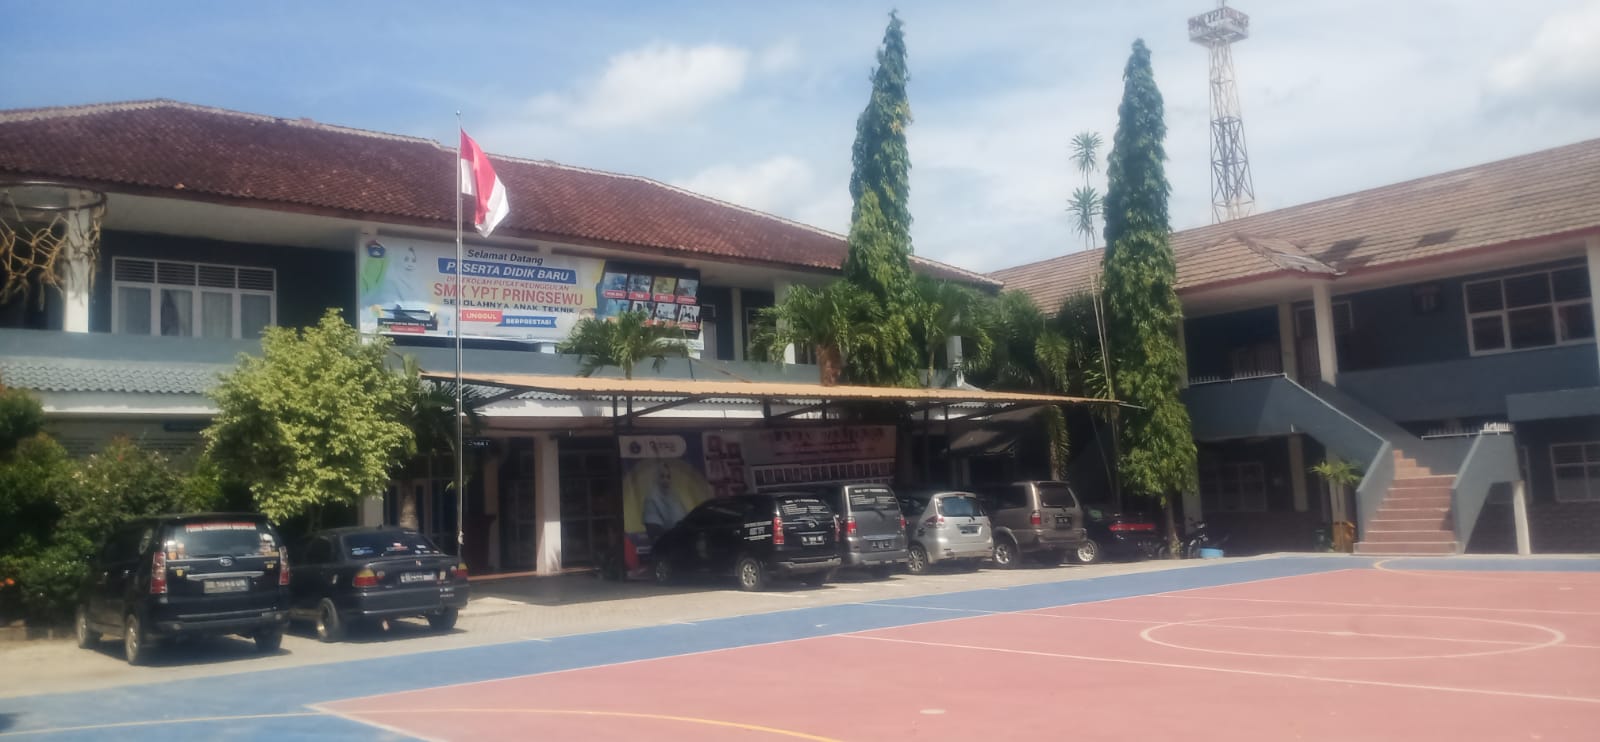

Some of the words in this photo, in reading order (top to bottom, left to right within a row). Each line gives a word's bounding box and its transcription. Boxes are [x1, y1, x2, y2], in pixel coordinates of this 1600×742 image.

[467, 249, 507, 261] Selamat
[510, 253, 544, 266] Datang
[446, 261, 500, 275] PSERTA
[503, 267, 535, 278] DIDIK
[537, 270, 570, 281] BARU
[459, 277, 493, 285] EKOLAH
[494, 279, 520, 287] PUSAT
[521, 282, 569, 291] KEUNGGULAN
[472, 286, 499, 300] YPT
[502, 288, 583, 306] PRINGSEWU
[443, 298, 509, 309] SEOLAHNYA
[514, 303, 538, 311] ANAK
[543, 305, 575, 314] TEKNIK
[466, 312, 497, 320] UNGGUL
